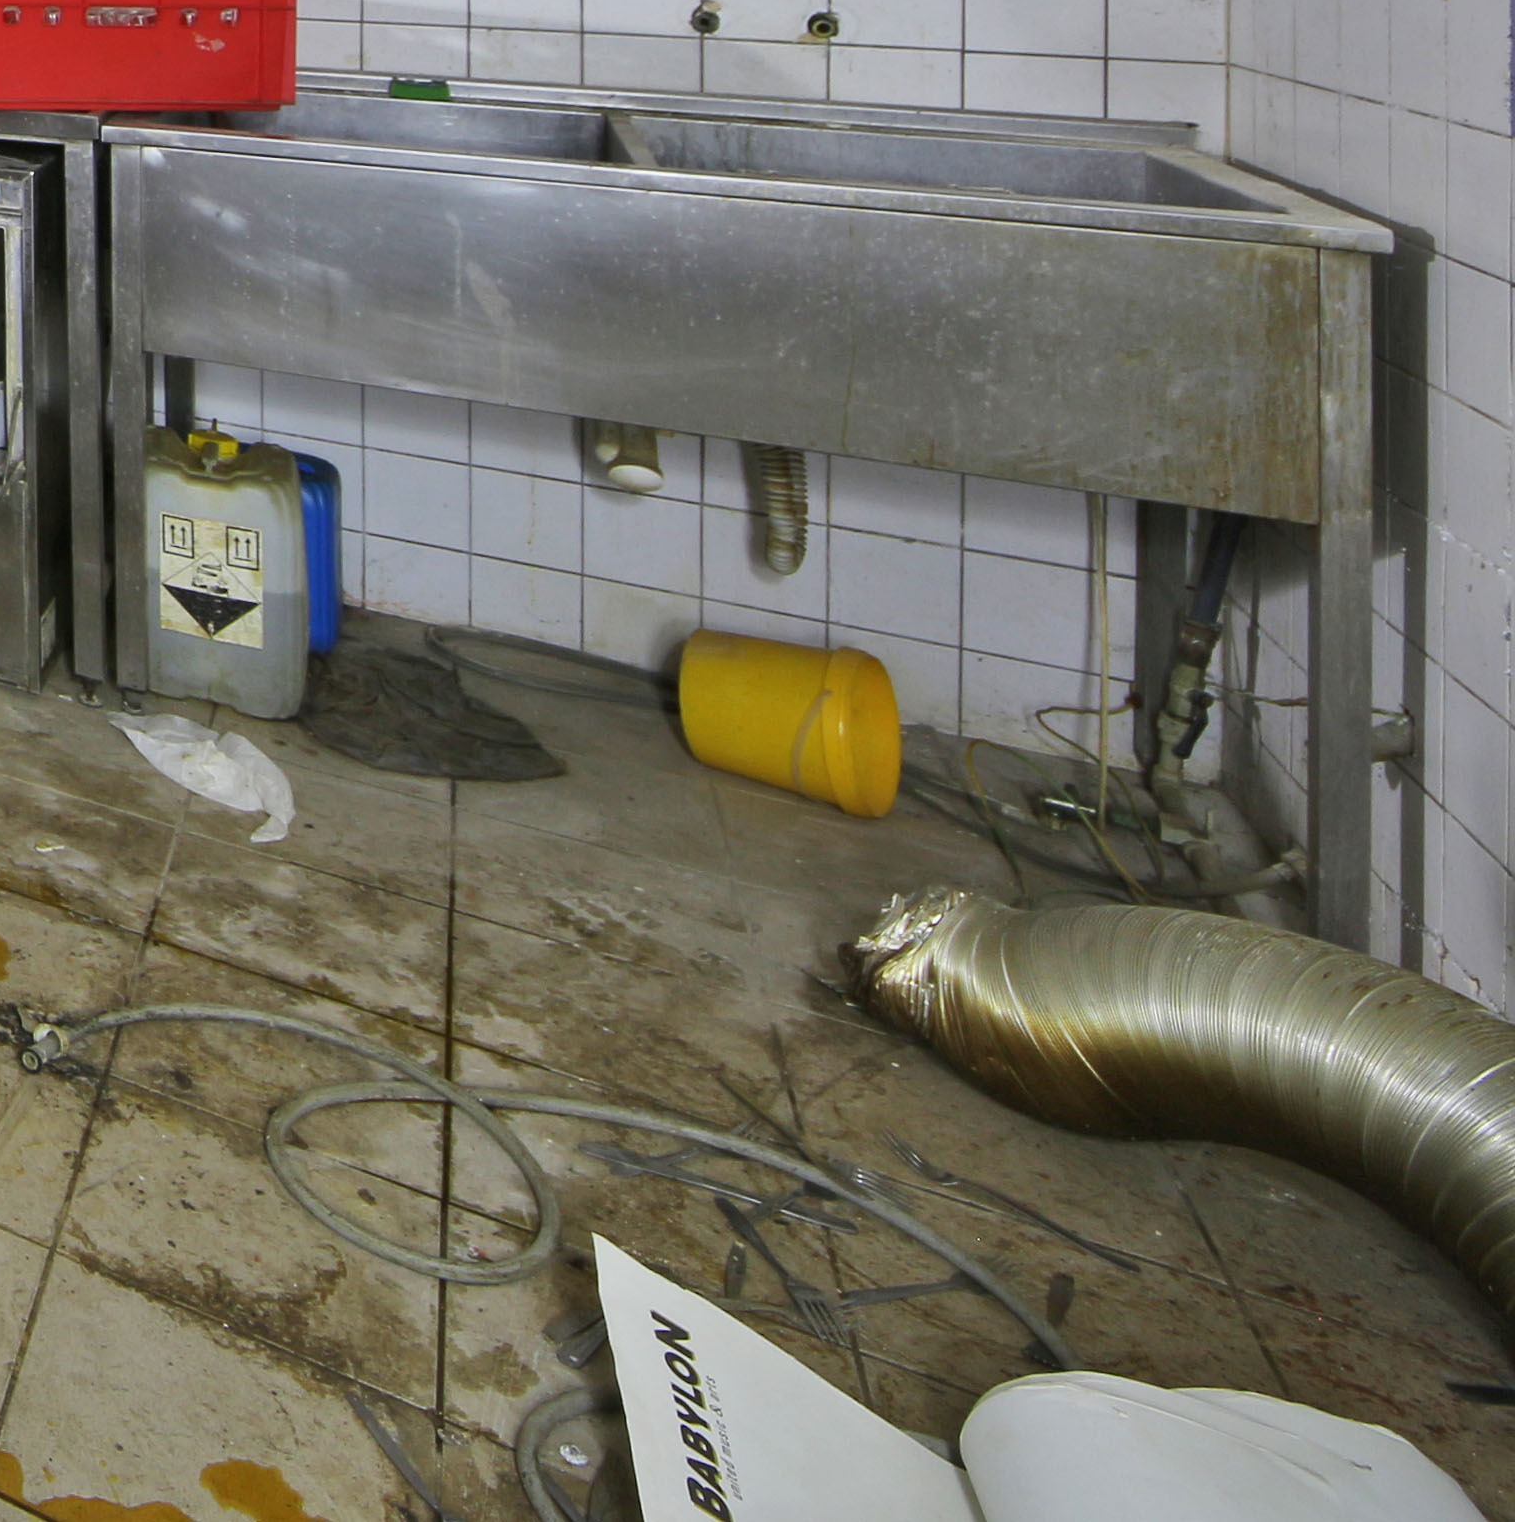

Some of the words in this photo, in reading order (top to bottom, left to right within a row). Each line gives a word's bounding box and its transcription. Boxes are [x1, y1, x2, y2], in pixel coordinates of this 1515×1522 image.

[649, 1309, 734, 1522] BABYLON
[709, 1404, 724, 1417] &
[715, 1420, 732, 1458] music
[721, 1458, 743, 1502] united
